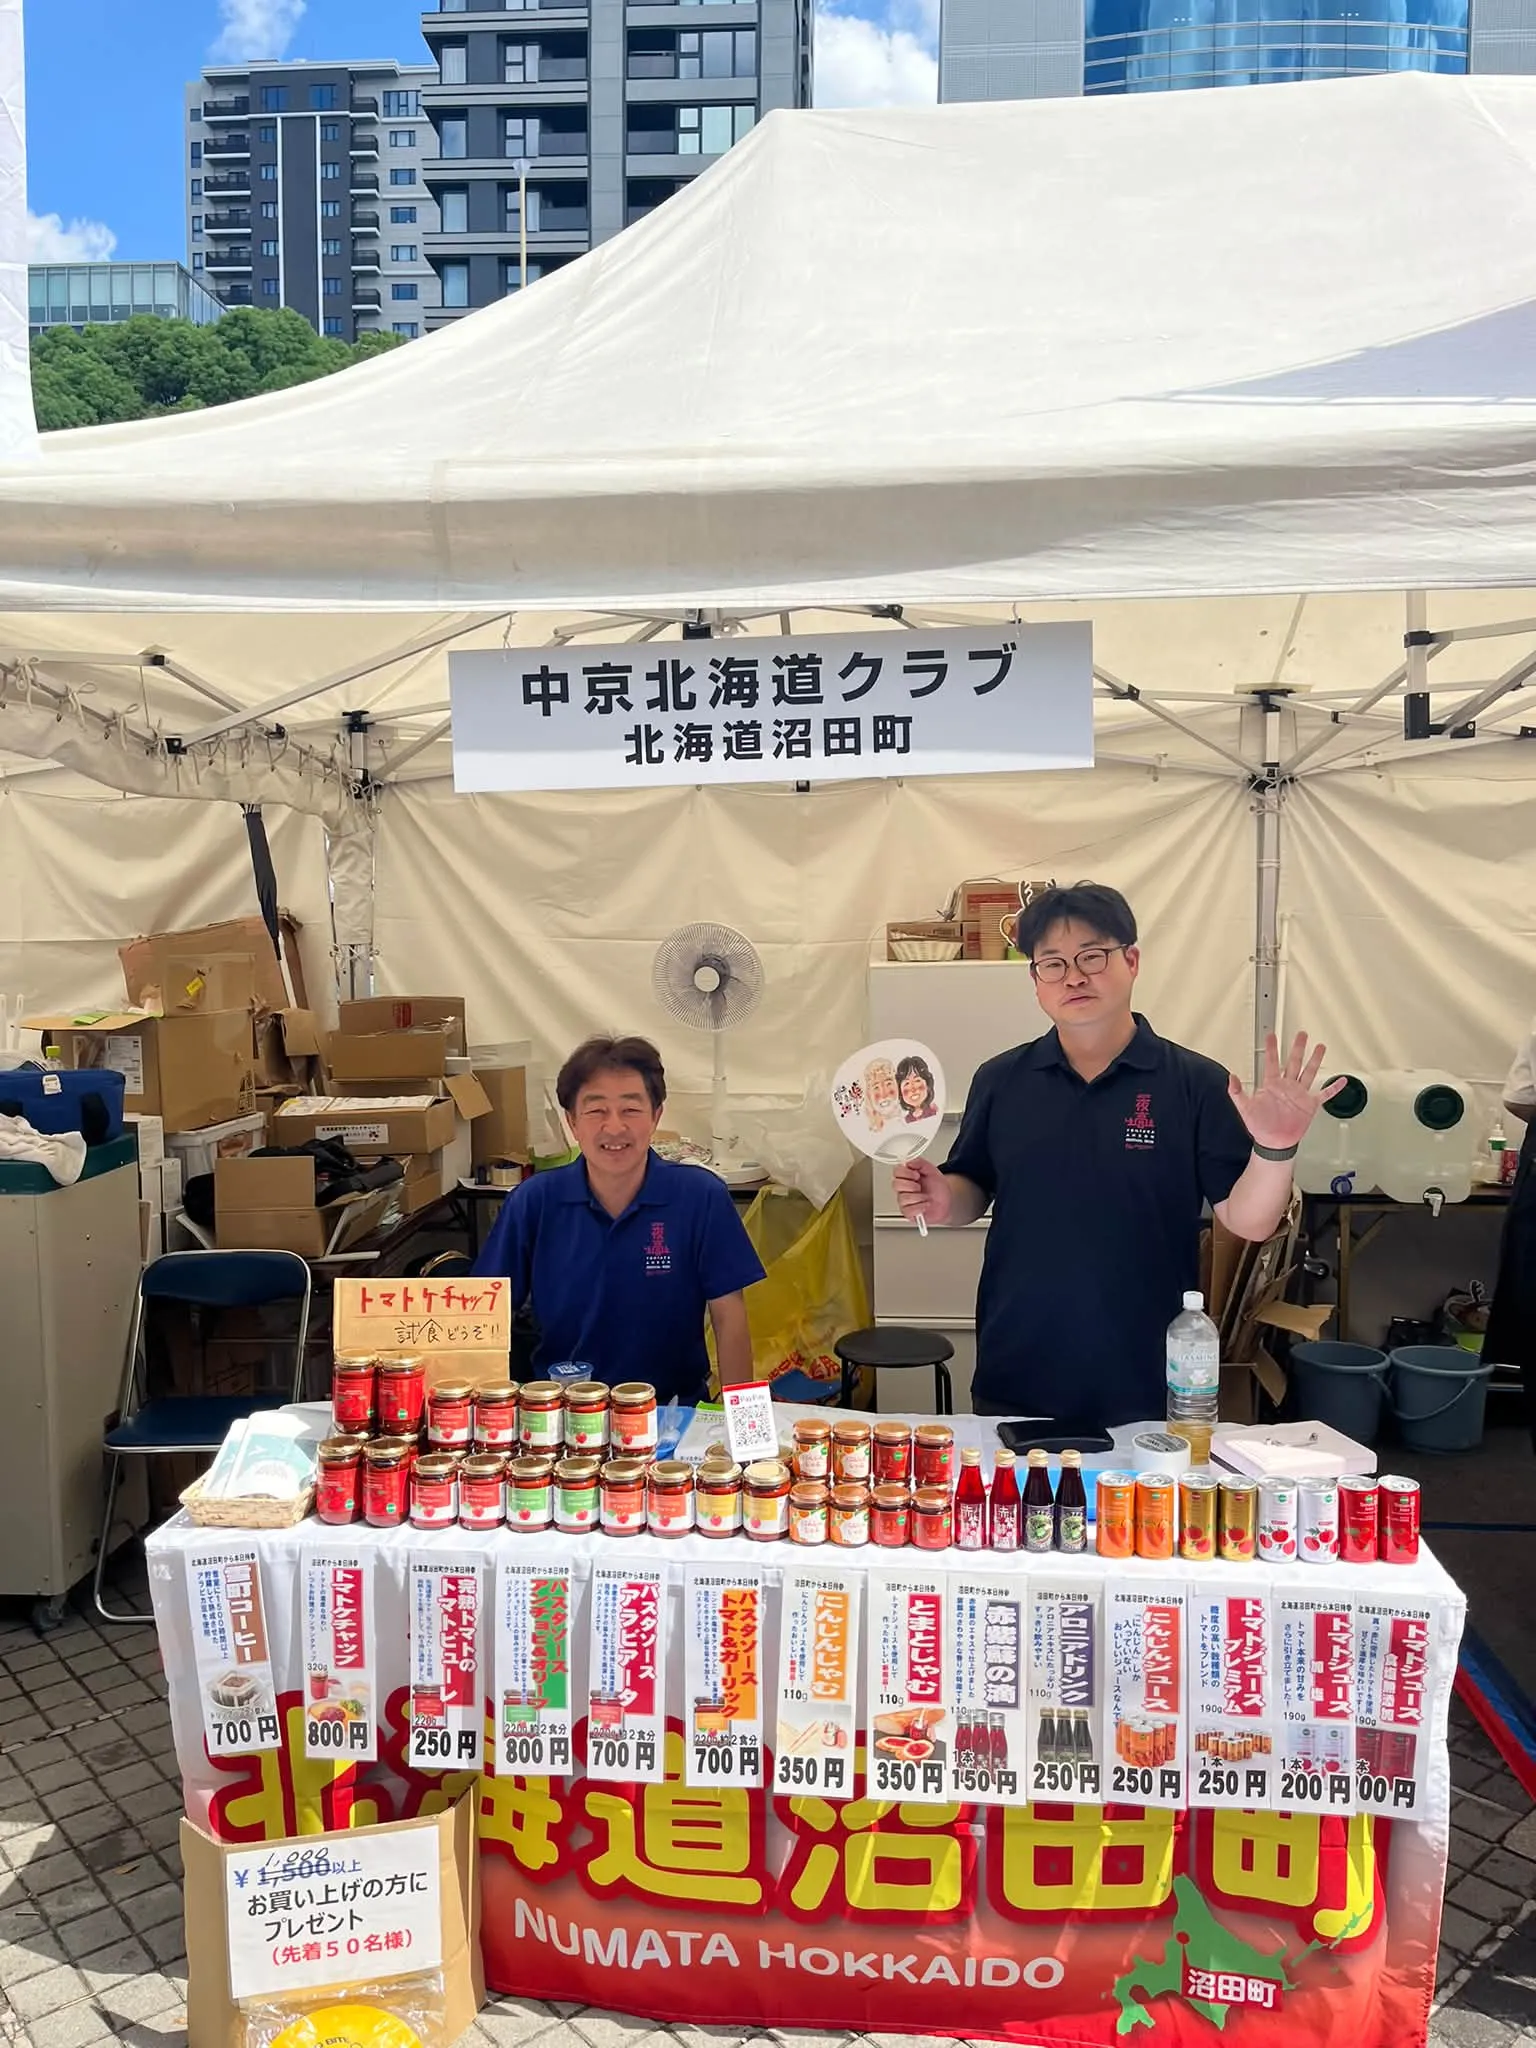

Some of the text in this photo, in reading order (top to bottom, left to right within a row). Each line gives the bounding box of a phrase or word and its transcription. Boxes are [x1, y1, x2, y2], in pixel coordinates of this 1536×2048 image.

[522, 641, 1018, 717] 中京北海道クラブ
[624, 714, 914, 766] 北海道沼田町
[360, 1281, 503, 1314] トマトケチャップ
[331, 1569, 359, 1666] トマトケチャップ
[457, 1578, 478, 1673] 完熟トマトの
[550, 1578, 569, 1674] パスタソース
[618, 1588, 640, 1707] アラビアータ
[639, 1583, 660, 1680] パスタソース
[739, 1590, 759, 1685] パスタソース
[811, 1594, 843, 1696] にんじんじゃむ
[1123, 1619, 1133, 1674] 入っていない
[1132, 1613, 1141, 1682] 「にんじん」しか
[307, 1662, 328, 1672] 320g
[1059, 1603, 1090, 1704] アロニアドリンク
[1142, 1610, 1173, 1711] にんじんジュース
[1223, 1638, 1244, 1714] プレミアム
[1240, 1599, 1267, 1708] トマトジュース
[1327, 1616, 1354, 1713] トマトジュース
[1397, 1624, 1430, 1721] トマトジュース
[415, 1714, 437, 1726] 220g
[783, 1688, 808, 1703] 110g
[879, 1693, 904, 1707] 110g
[1200, 1704, 1222, 1714] 190g
[1283, 1711, 1306, 1722] 190g
[1201, 1756, 1223, 1768] 1本
[1280, 1757, 1303, 1770] 1本
[1355, 1775, 1416, 1809] 00円
[247, 1871, 428, 1917] お買い上げの方に
[264, 1908, 364, 1943] プレゼント
[272, 1928, 413, 1967] （先着５０名様）
[514, 1897, 1067, 1990] NUMATA HOKKAIDO
[1187, 1968, 1277, 2009] 沼田町
